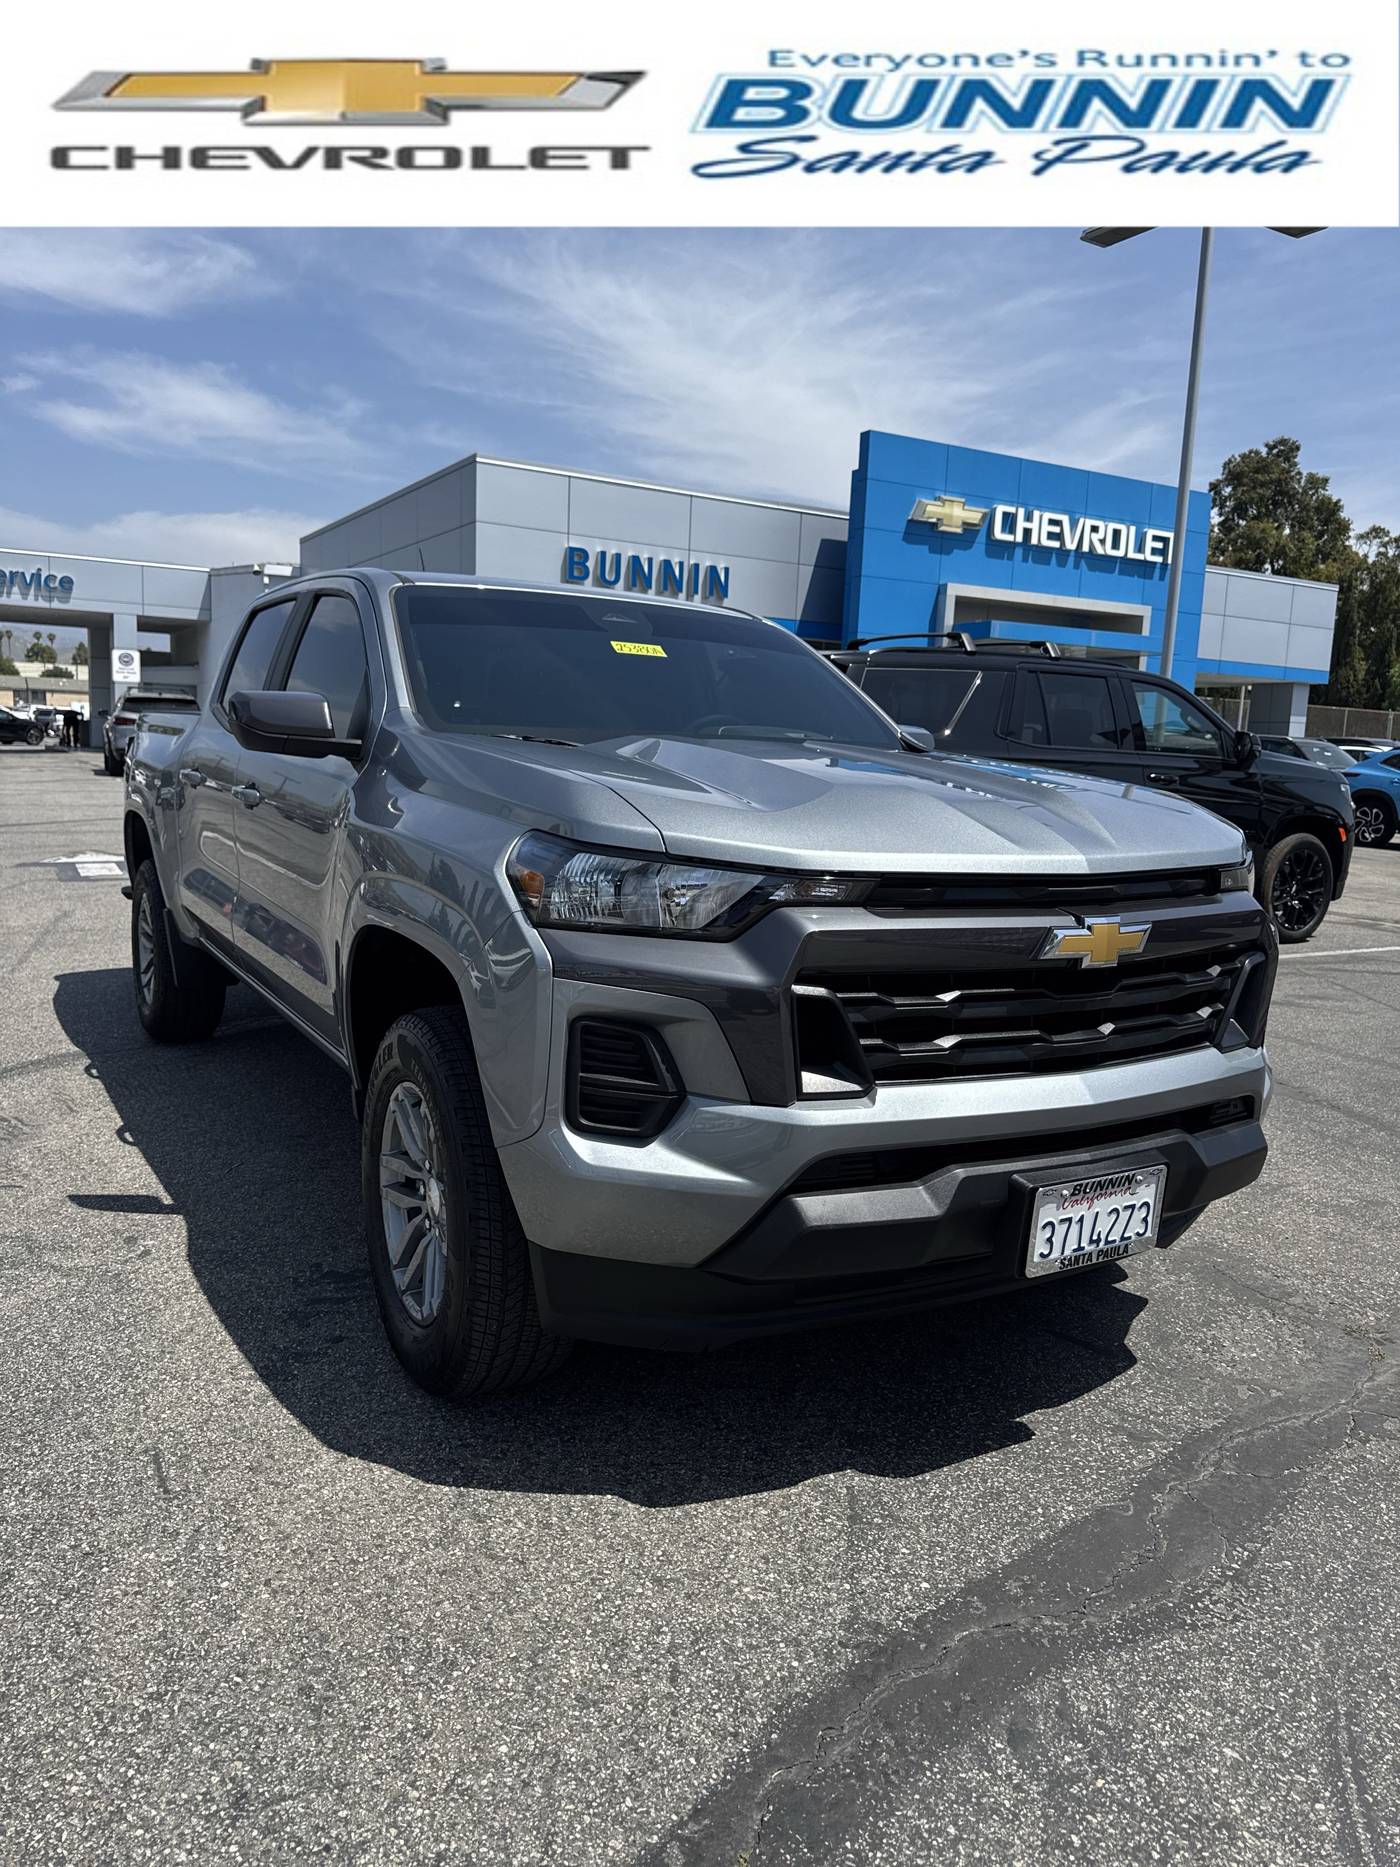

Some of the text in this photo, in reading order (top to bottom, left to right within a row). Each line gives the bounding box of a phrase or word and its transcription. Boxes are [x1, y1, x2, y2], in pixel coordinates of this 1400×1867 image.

[565, 546, 730, 599] BUNNIN
[1071, 1173, 1135, 1197] BUNNIN
[1059, 1245, 1129, 1270] SANTA PAULA
